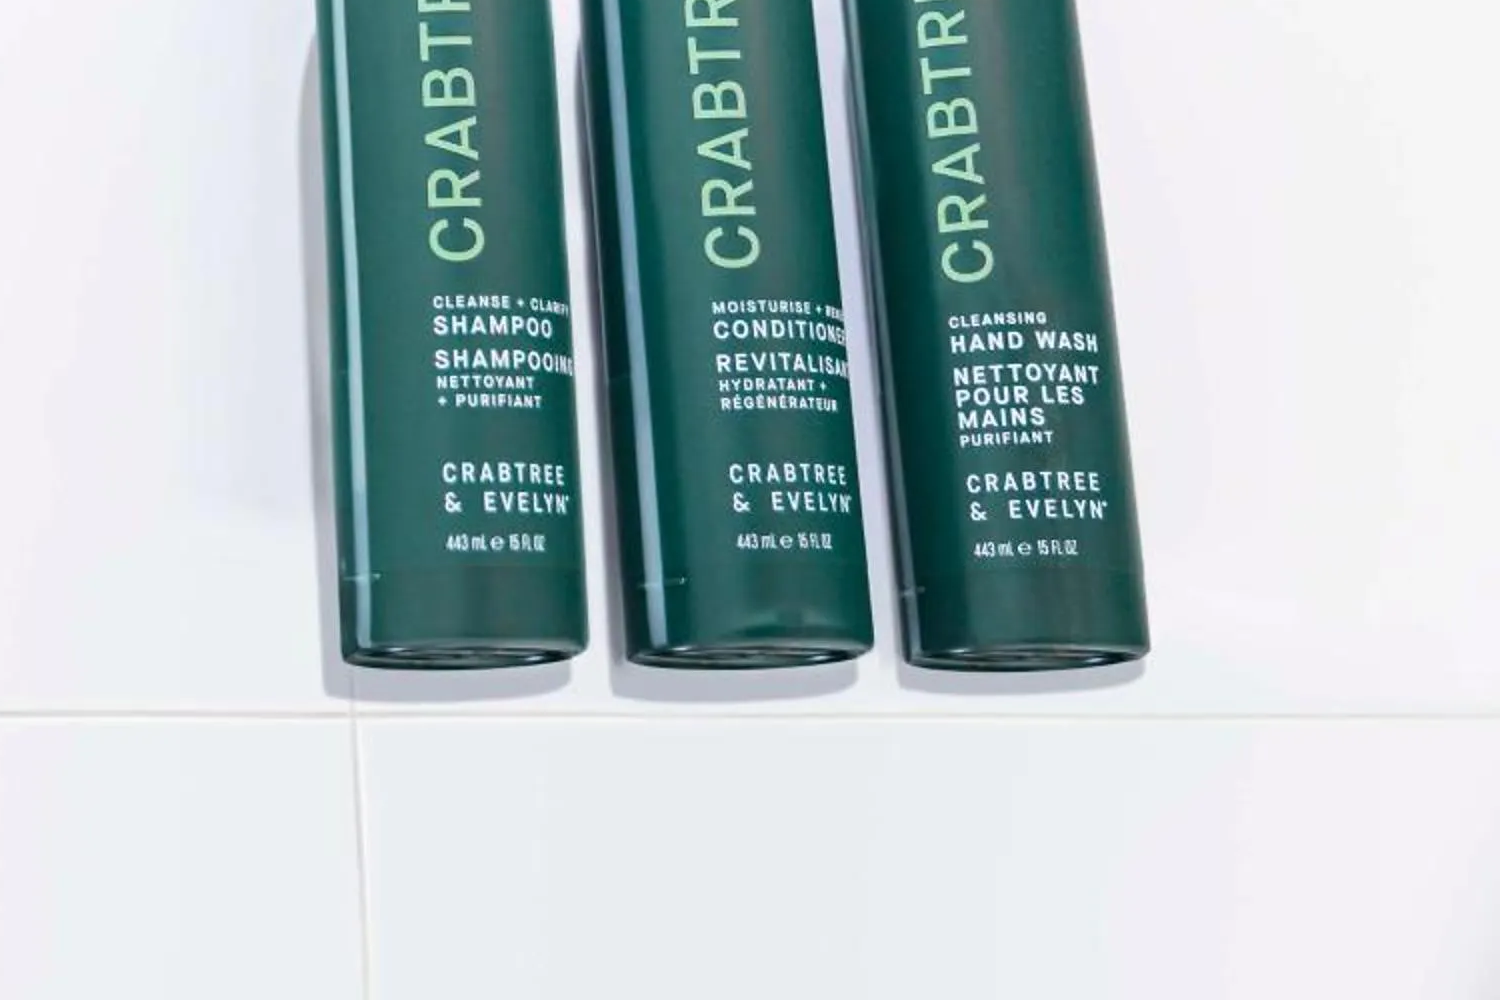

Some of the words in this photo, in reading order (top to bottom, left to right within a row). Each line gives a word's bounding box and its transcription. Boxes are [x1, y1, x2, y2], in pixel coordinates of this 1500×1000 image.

[433, 295, 510, 309] CLEANSE
[712, 300, 811, 315] MOISTURISE
[433, 315, 552, 338] SHAMPOO
[949, 311, 1047, 329] CLEANSING
[951, 331, 1024, 354] HAND
[1035, 330, 1098, 353] WASH
[436, 375, 535, 389] NETTOYANT
[954, 363, 1099, 386] NETTOYANT
[719, 378, 815, 392] HYDRATANT
[456, 393, 542, 408] PURIFIANT
[721, 394, 838, 412] RÉGÉNÉRATEUR
[956, 386, 1028, 408] POUR
[1041, 385, 1084, 406] LES
[958, 407, 1046, 429] MAINS
[960, 431, 1053, 448] PURIFIANT
[442, 462, 565, 486] CRABTREE
[729, 463, 847, 485] CRABTREE
[967, 471, 1100, 493] CRABTREE
[445, 492, 462, 513] &
[733, 492, 750, 512] &
[970, 502, 987, 521] &
[446, 533, 469, 551] 443
[737, 533, 758, 549] 443
[974, 541, 996, 558] 443
[1037, 539, 1049, 555] 15
